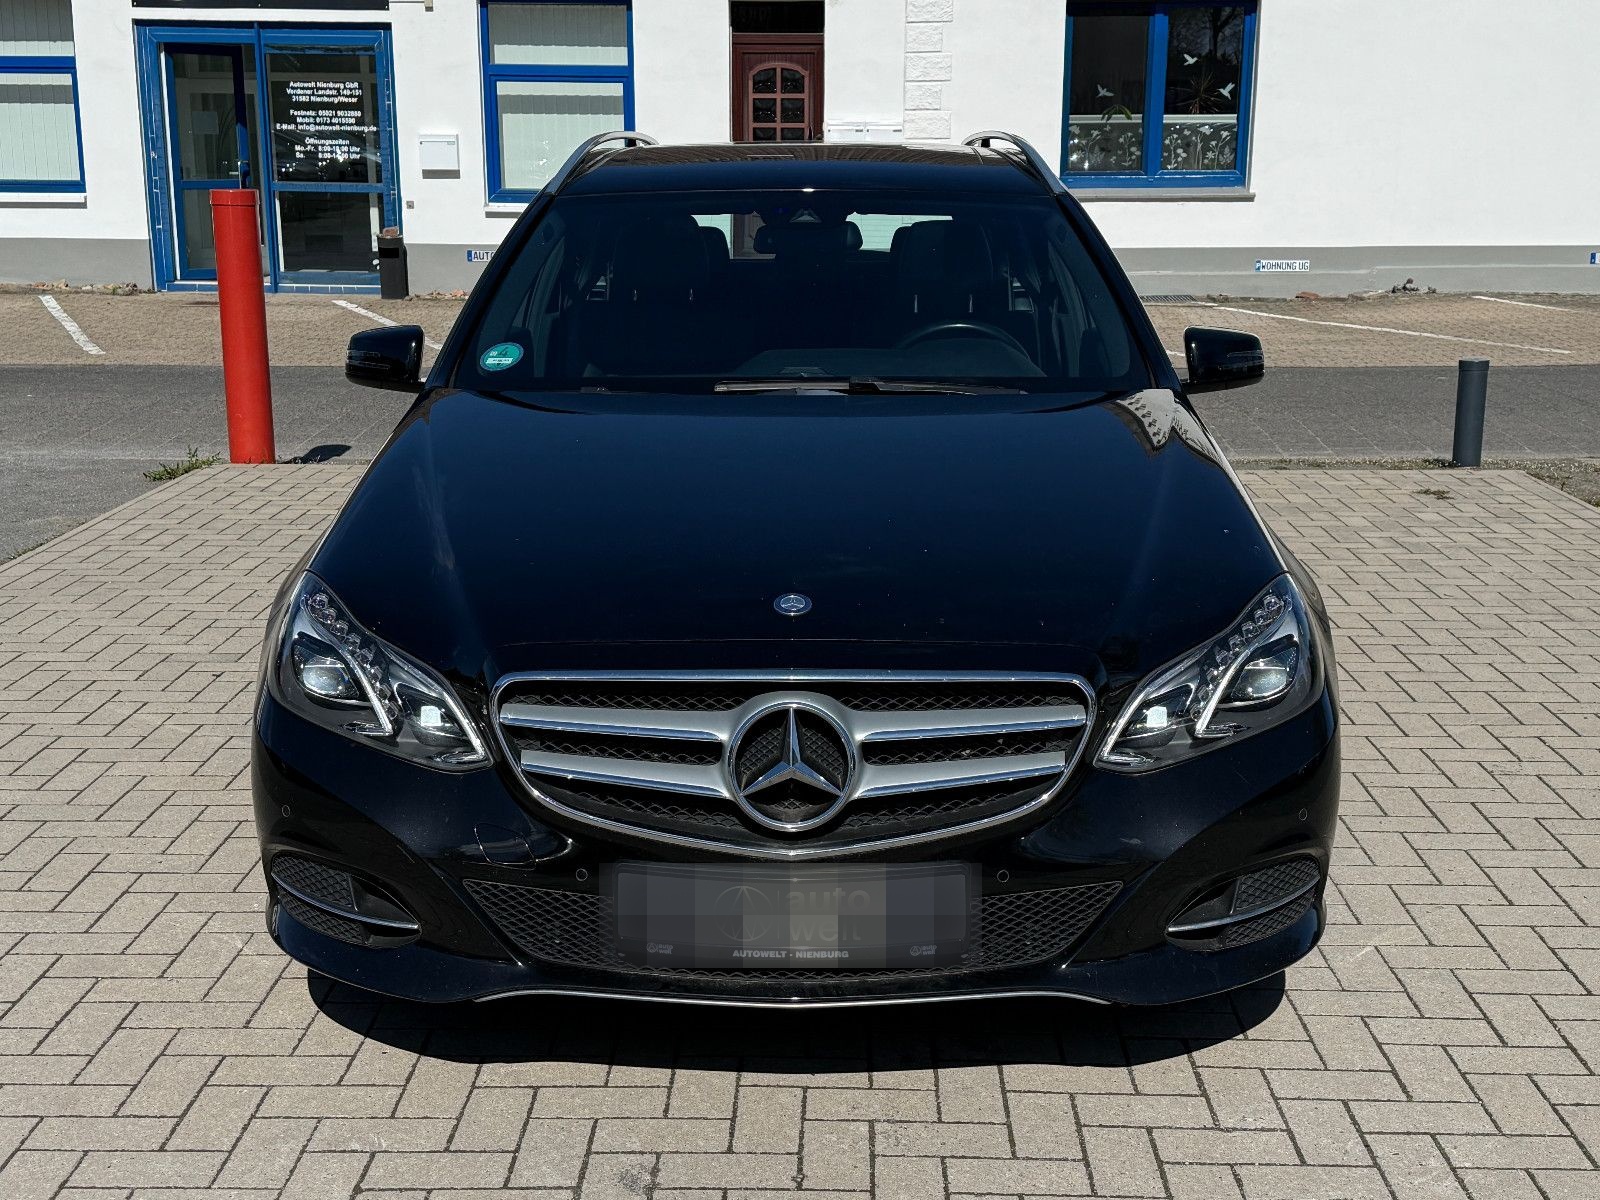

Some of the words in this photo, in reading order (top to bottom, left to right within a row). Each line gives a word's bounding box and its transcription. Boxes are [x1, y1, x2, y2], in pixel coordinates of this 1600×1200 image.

[311, 96, 358, 104] Nienburg/Weser
[1261, 261, 1297, 270] WOHNUNG
[1299, 261, 1309, 270] UG
[732, 949, 787, 958] AUTOWELT
[795, 950, 849, 959] NIENBURG
